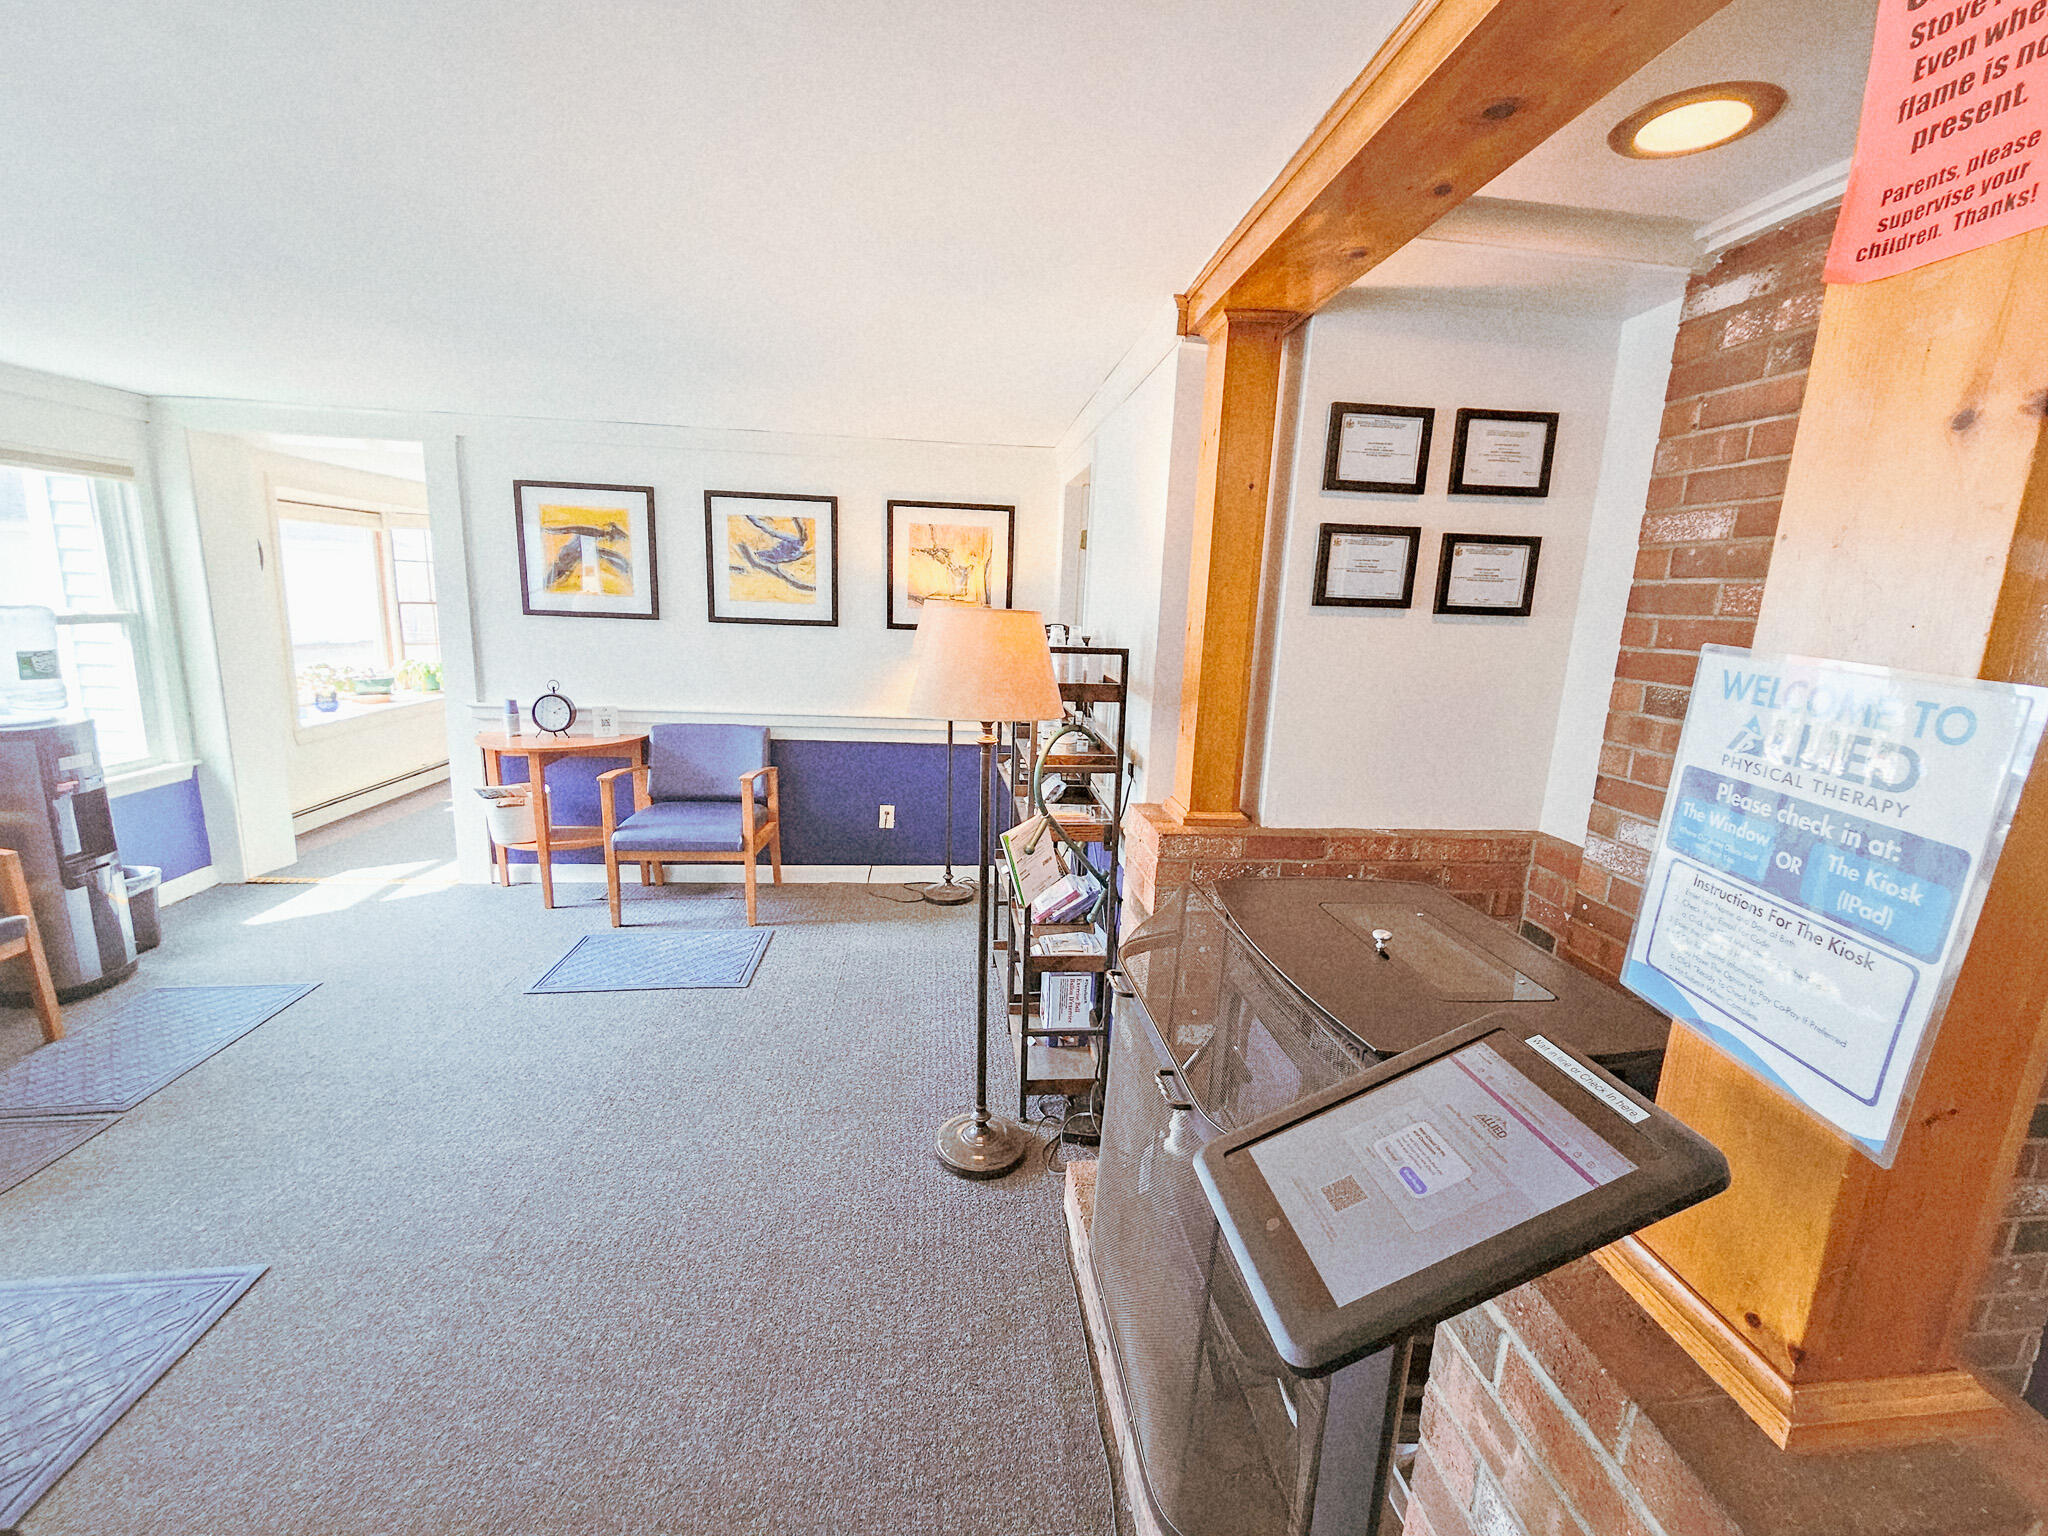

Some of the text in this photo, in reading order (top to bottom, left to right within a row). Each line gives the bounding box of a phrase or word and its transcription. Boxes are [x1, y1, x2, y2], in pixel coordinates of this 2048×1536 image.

[1909, 0, 1986, 49] Stove
[1912, 0, 2048, 84] Even whe
[1897, 71, 1976, 124] flame
[1982, 57, 2010, 85] is
[1965, 129, 2042, 176] please
[1855, 182, 2040, 262] children. Thanks!
[1877, 160, 2031, 233] supervise your
[1913, 699, 1978, 746] TO
[1721, 753, 1911, 819] PHYSICAL THERAPY
[1681, 801, 1706, 823] The
[1709, 809, 1771, 847] Window
[1716, 782, 1903, 863] Please check in at:
[1775, 851, 1803, 876] OR
[1828, 853, 1924, 908] The Kiosk
[1693, 873, 1764, 919] Instructions
[1768, 908, 1793, 931] For
[1797, 920, 1824, 947] The
[1827, 936, 1876, 972] Kiosk
[1580, 1072, 1607, 1093] Check
